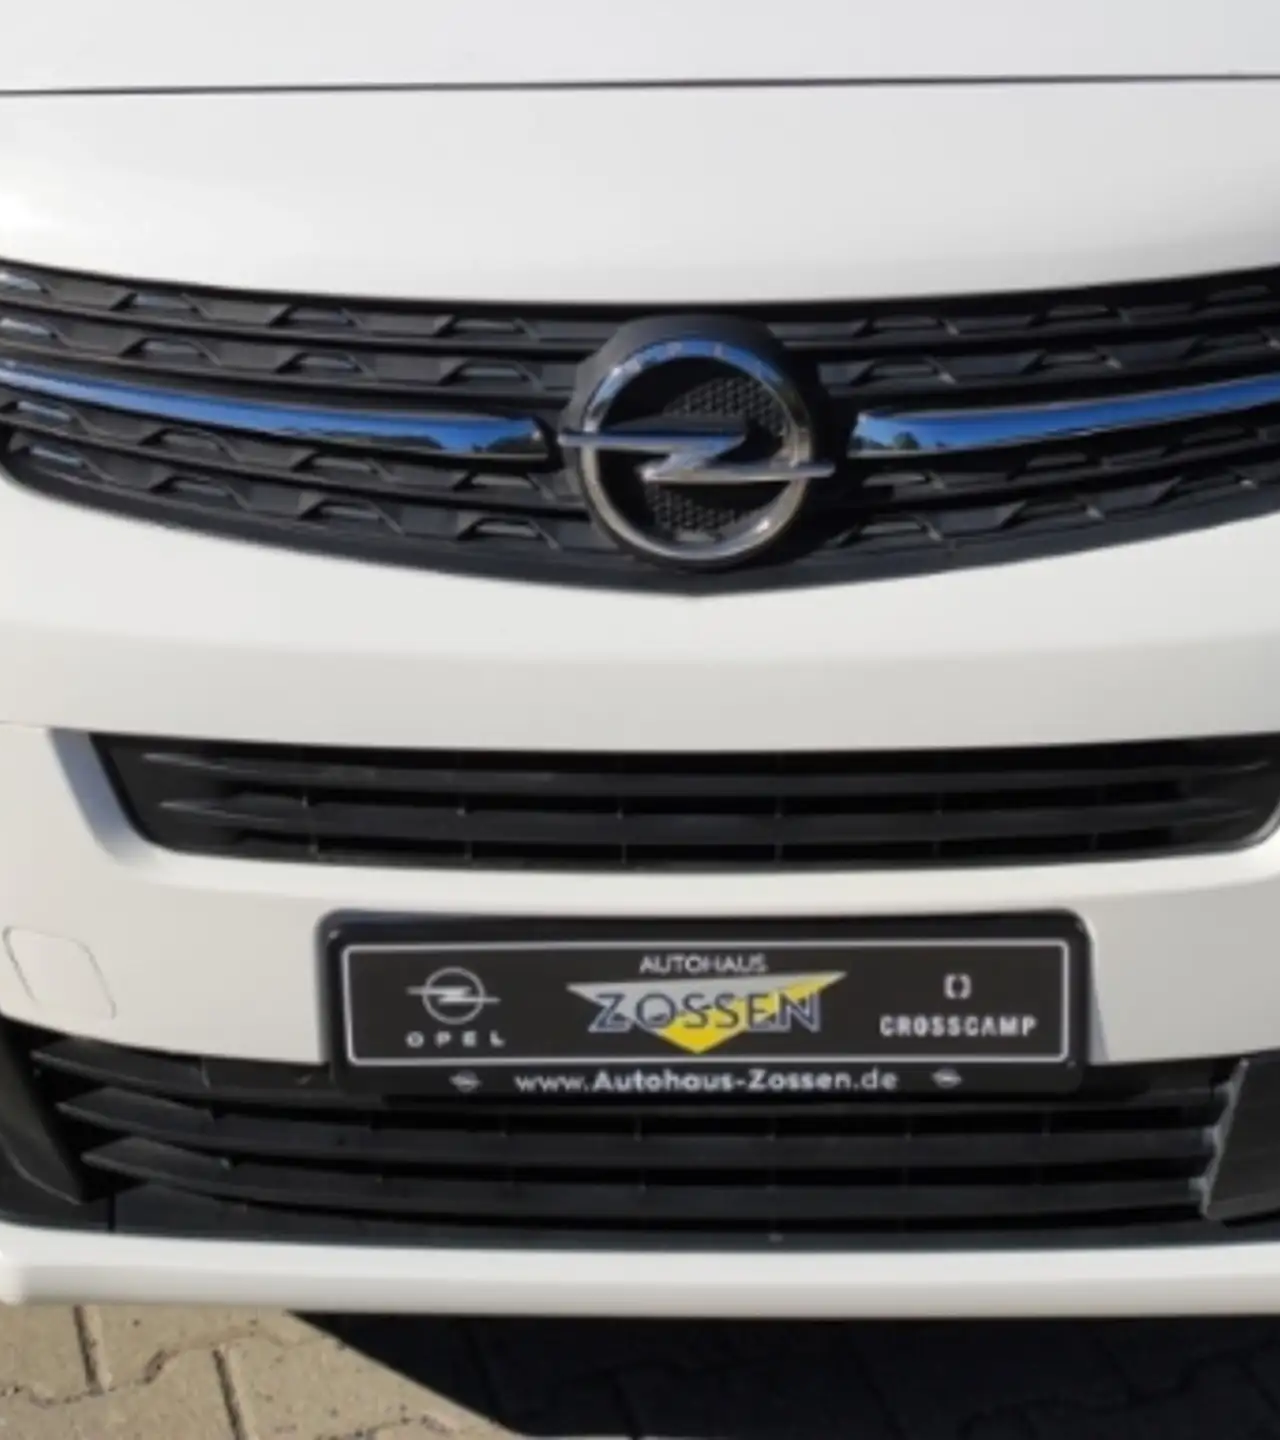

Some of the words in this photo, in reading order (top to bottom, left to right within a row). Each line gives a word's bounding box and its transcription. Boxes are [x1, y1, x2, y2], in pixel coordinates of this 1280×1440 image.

[638, 953, 769, 975] AUTOHAUS
[587, 991, 821, 1034] ZOSSEN
[878, 1014, 1038, 1037] CROSSCAMP
[405, 1030, 506, 1049] OPEL
[513, 1064, 898, 1093] www.Autohaus-Zossen.de
